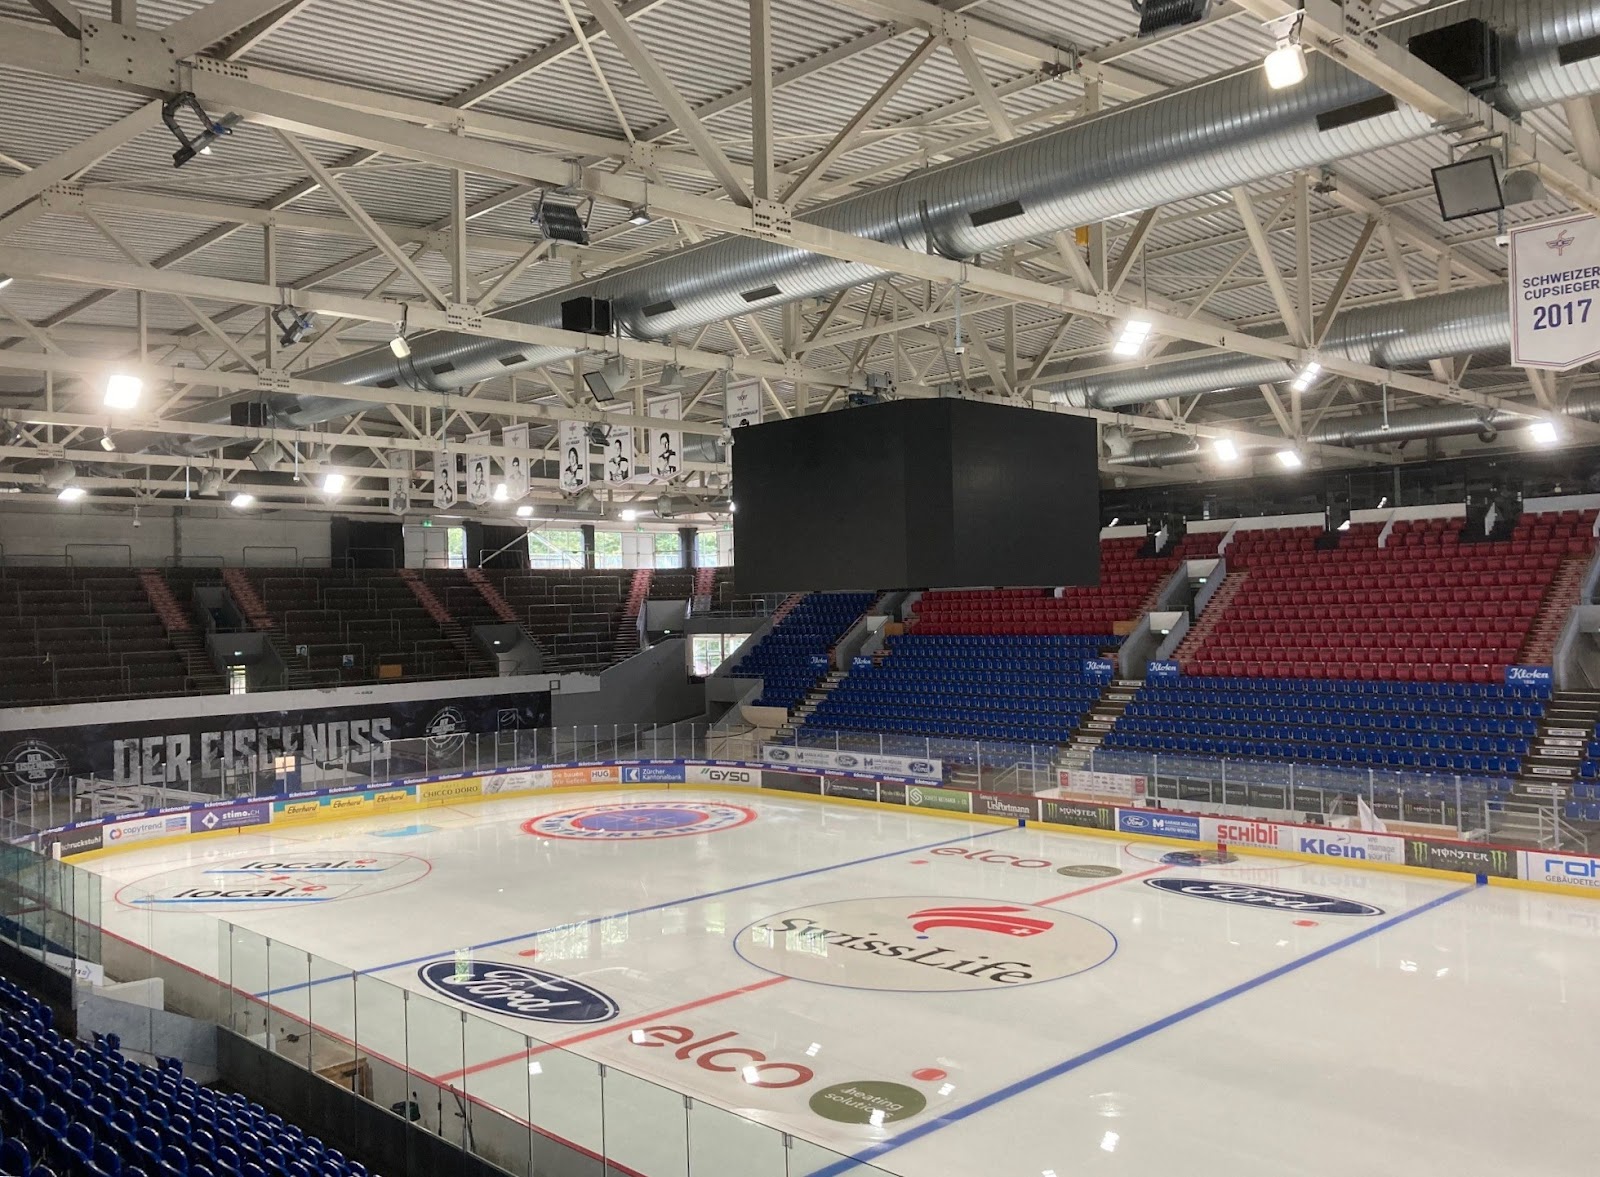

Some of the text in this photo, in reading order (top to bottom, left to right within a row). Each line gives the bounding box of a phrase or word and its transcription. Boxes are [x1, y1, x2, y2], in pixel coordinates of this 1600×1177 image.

[1523, 266, 1600, 289] SCHWEIZER
[1524, 279, 1600, 300] CUPSIEGER
[1533, 298, 1592, 330] 2017
[1086, 661, 1111, 670] Kloten
[1149, 662, 1176, 671] Kloten
[1509, 667, 1549, 679] Kloten
[113, 734, 191, 785] DER
[591, 770, 609, 778] HUG
[709, 770, 750, 783] GYSO
[377, 793, 405, 803] Eberhard
[423, 789, 453, 799] CHICCO
[455, 786, 478, 794] DORO
[160, 805, 192, 813] ticketmaster
[204, 800, 236, 808] ticketmaster
[287, 804, 318, 814] Eberhard
[333, 799, 361, 809] Eberhard
[116, 811, 148, 820] ticketmaster
[222, 809, 260, 820] stimo.CH
[1059, 807, 1097, 818] MONSTER
[123, 821, 163, 835] copytrend
[1301, 838, 1366, 859] Klein
[1367, 845, 1395, 853] manage
[1431, 847, 1489, 862] MONSTER
[930, 847, 1052, 868] elco
[1367, 853, 1383, 861] your
[1182, 884, 1334, 909] Ford
[442, 970, 582, 1012] Ford
[628, 1025, 814, 1089] elco
[824, 1092, 894, 1119] solutios
[841, 1087, 904, 1111] heating
